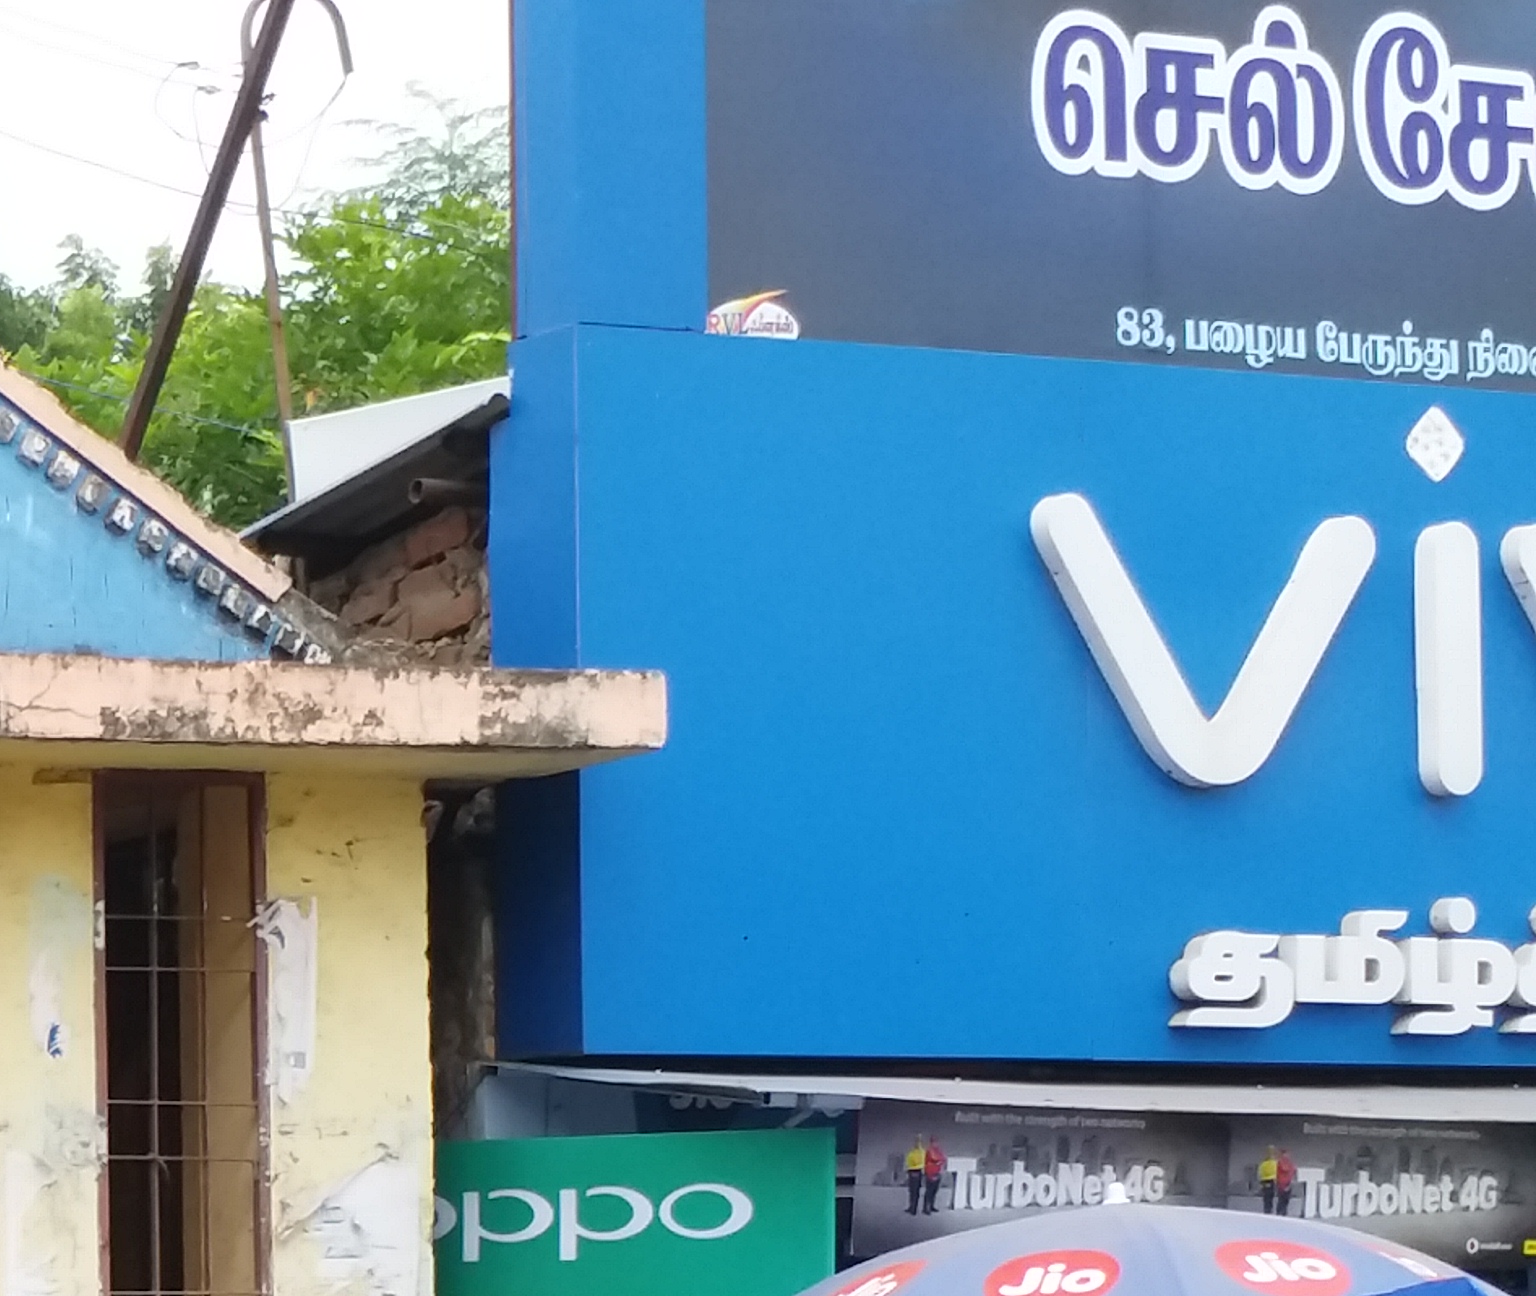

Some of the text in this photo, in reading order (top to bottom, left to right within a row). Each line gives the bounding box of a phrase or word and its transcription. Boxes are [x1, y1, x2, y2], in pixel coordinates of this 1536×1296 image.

[1031, 5, 1536, 211] செல் சே
[1116, 306, 1176, 355] 83,
[1184, 316, 1307, 370] பழைய
[1316, 319, 1460, 382] பேருந்து
[1030, 493, 1536, 797] VI
[1168, 896, 1536, 1036] தமிழ்
[947, 1156, 1165, 1211] TurboNet 4G
[1297, 1167, 1499, 1219] TurboNet 4G
[998, 1262, 1106, 1296] Jio
[1243, 1251, 1337, 1283] Jio
